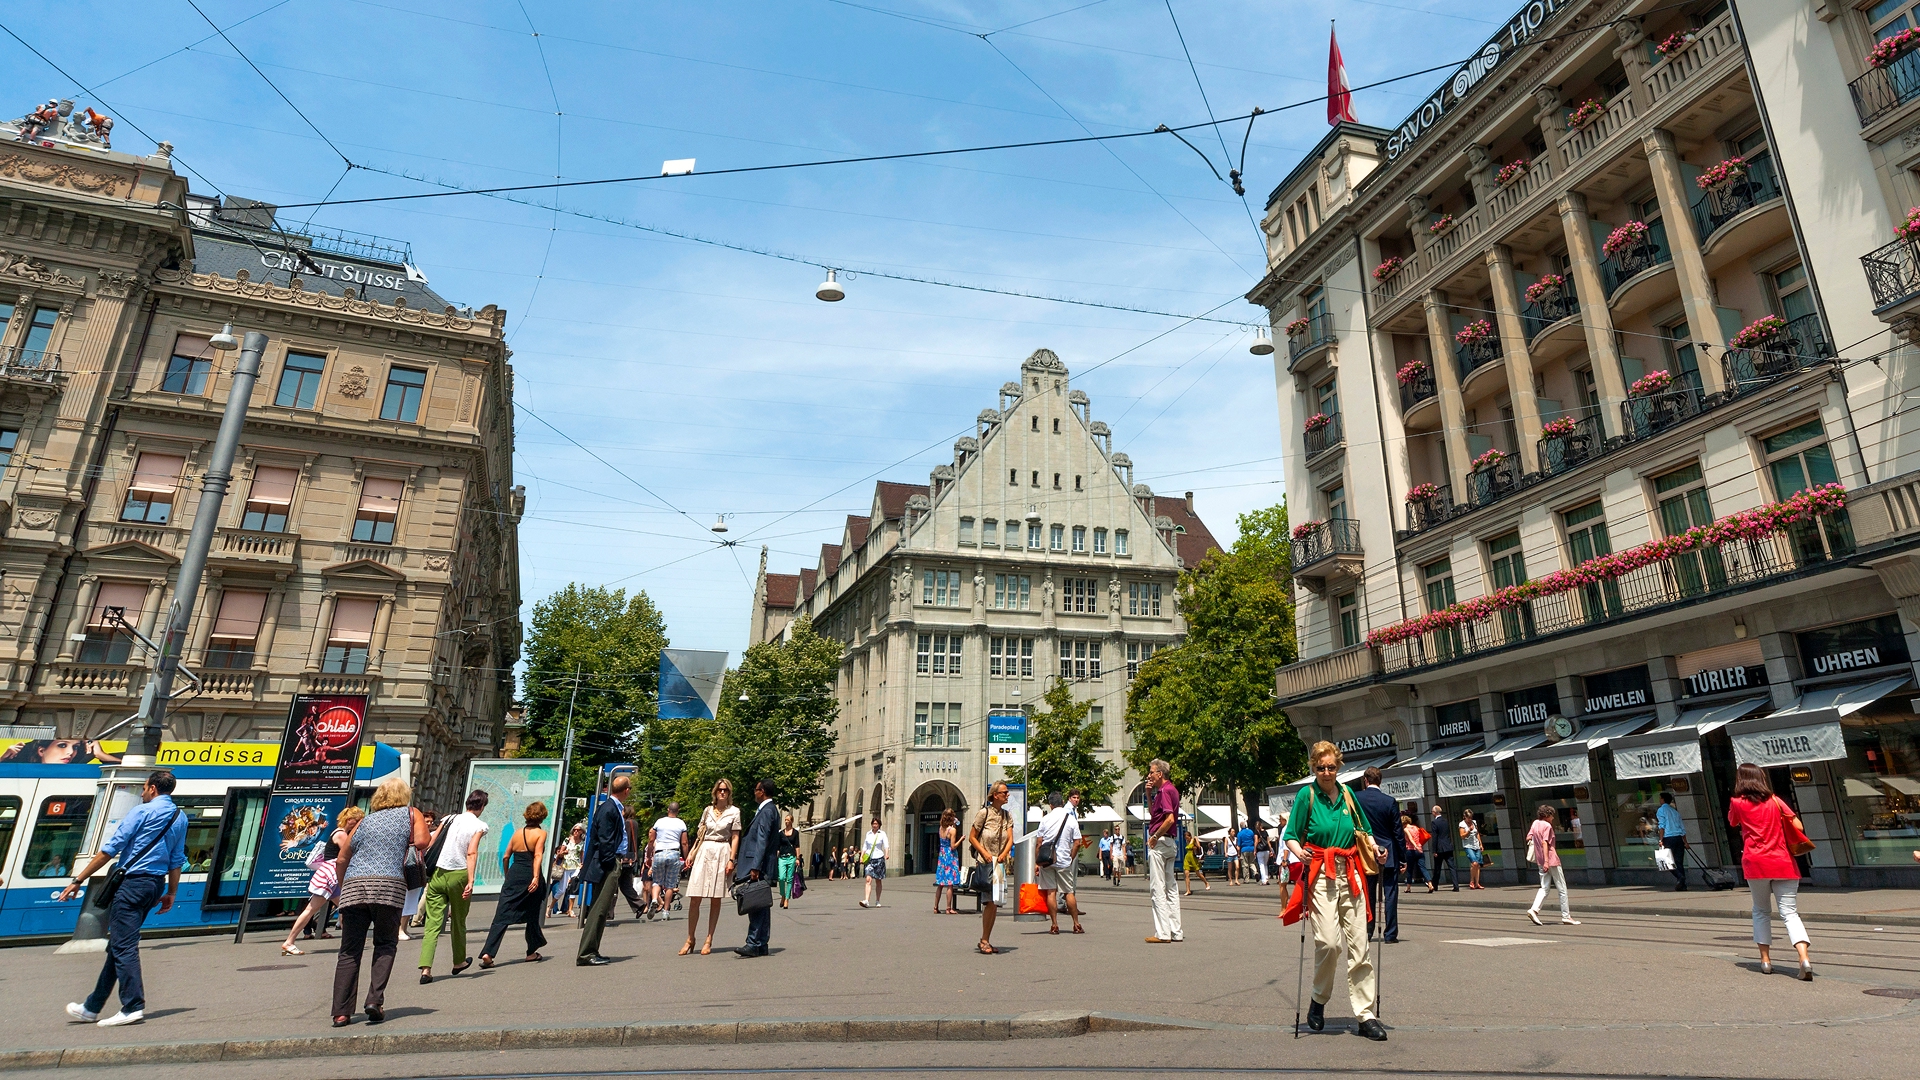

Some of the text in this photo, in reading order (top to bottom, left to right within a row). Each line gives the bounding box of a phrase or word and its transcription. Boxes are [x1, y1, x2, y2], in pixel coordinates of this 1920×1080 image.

[1387, 90, 1445, 160] SAVOY
[340, 265, 405, 291] SUISSE
[1813, 647, 1880, 673] UHREN
[1689, 665, 1748, 694] TÜRLER
[1585, 689, 1646, 713] JUWELEN
[1507, 702, 1548, 725] TÜRLER
[316, 719, 356, 733] Ohlala
[1439, 720, 1471, 737] UHREN
[992, 734, 999, 742] 11
[1335, 732, 1391, 753] ARSANO
[1762, 735, 1812, 756] TÜRLER
[160, 745, 263, 763] modissa
[1637, 751, 1676, 769] TÜRLER
[919, 760, 958, 771] GRIEDER
[1537, 763, 1569, 779] TÜRLER
[1387, 781, 1410, 795] TÜRLER
[1452, 774, 1480, 789] TÜRLER
[53, 803, 61, 813] 6
